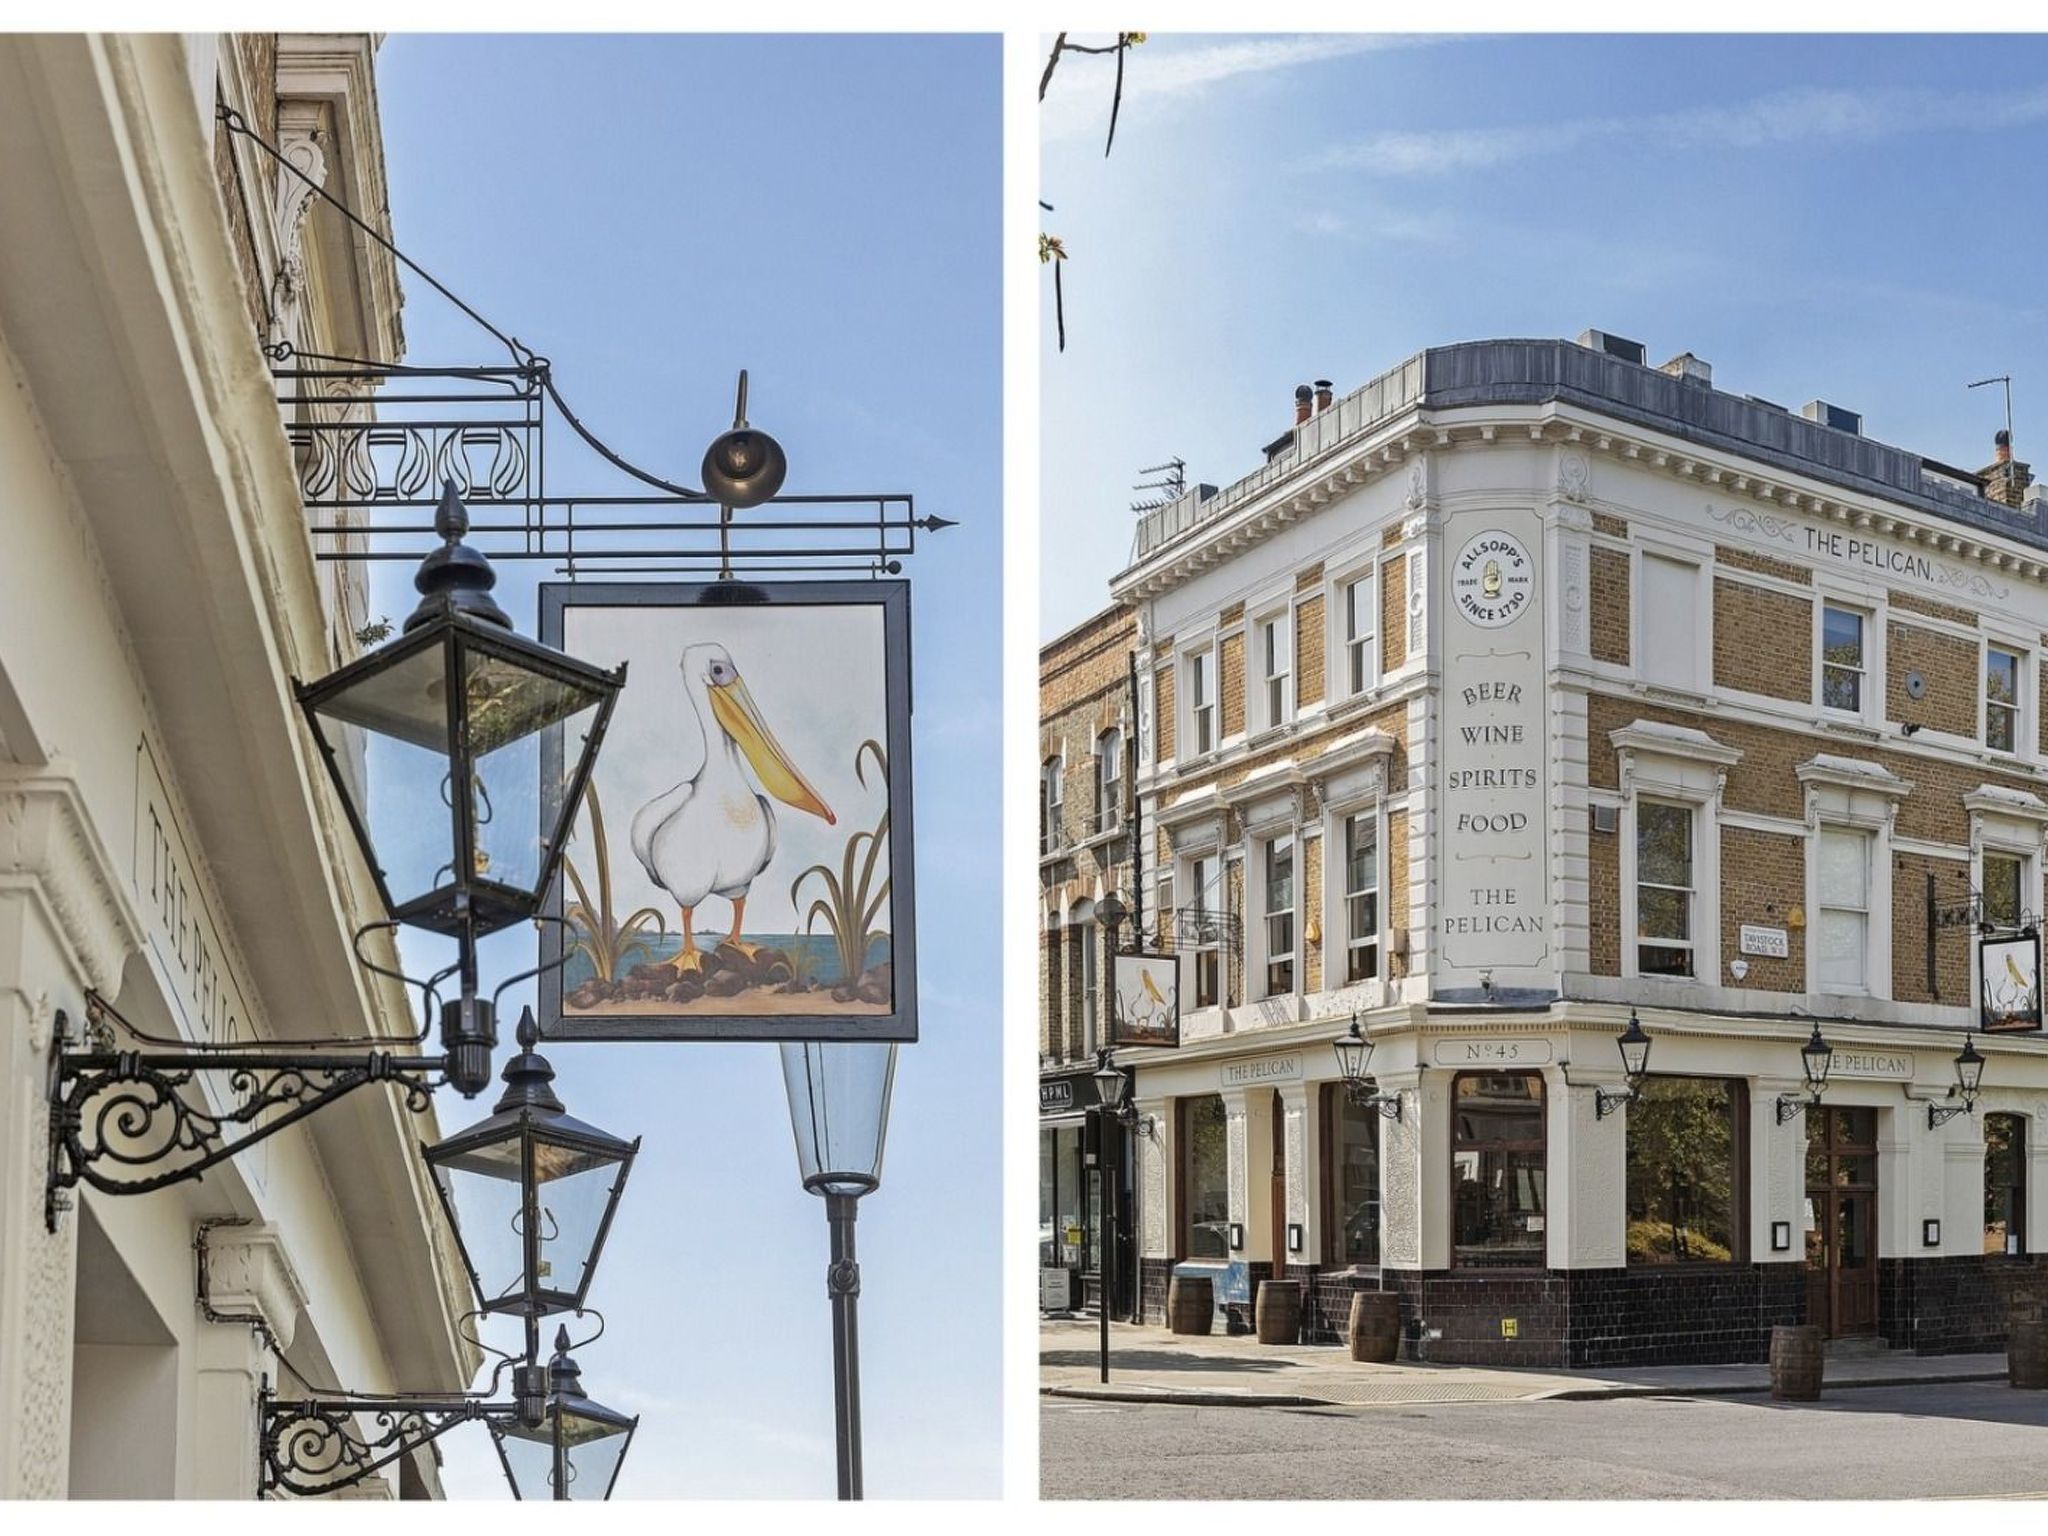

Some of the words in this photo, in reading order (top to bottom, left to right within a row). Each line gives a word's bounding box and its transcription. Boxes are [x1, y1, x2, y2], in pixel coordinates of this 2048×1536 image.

[1804, 526, 1842, 557] THE
[1461, 540, 1525, 570] ALLSOPP'S
[1461, 593, 1495, 620] SINCE
[1498, 592, 1525, 618] 1730
[1462, 681, 1522, 705] BEER
[1460, 725, 1524, 746] WINE
[1449, 768, 1537, 790] SPIRITS
[1457, 812, 1528, 834] FOOD
[149, 800, 188, 974] THE
[1470, 888, 1517, 905] THE
[1444, 915, 1544, 935] PELICAN
[1226, 1063, 1248, 1081] THE
[1250, 1058, 1294, 1078] PELICAN
[1845, 1055, 1906, 1073] PELICAN
[1504, 1320, 1516, 1335] H
